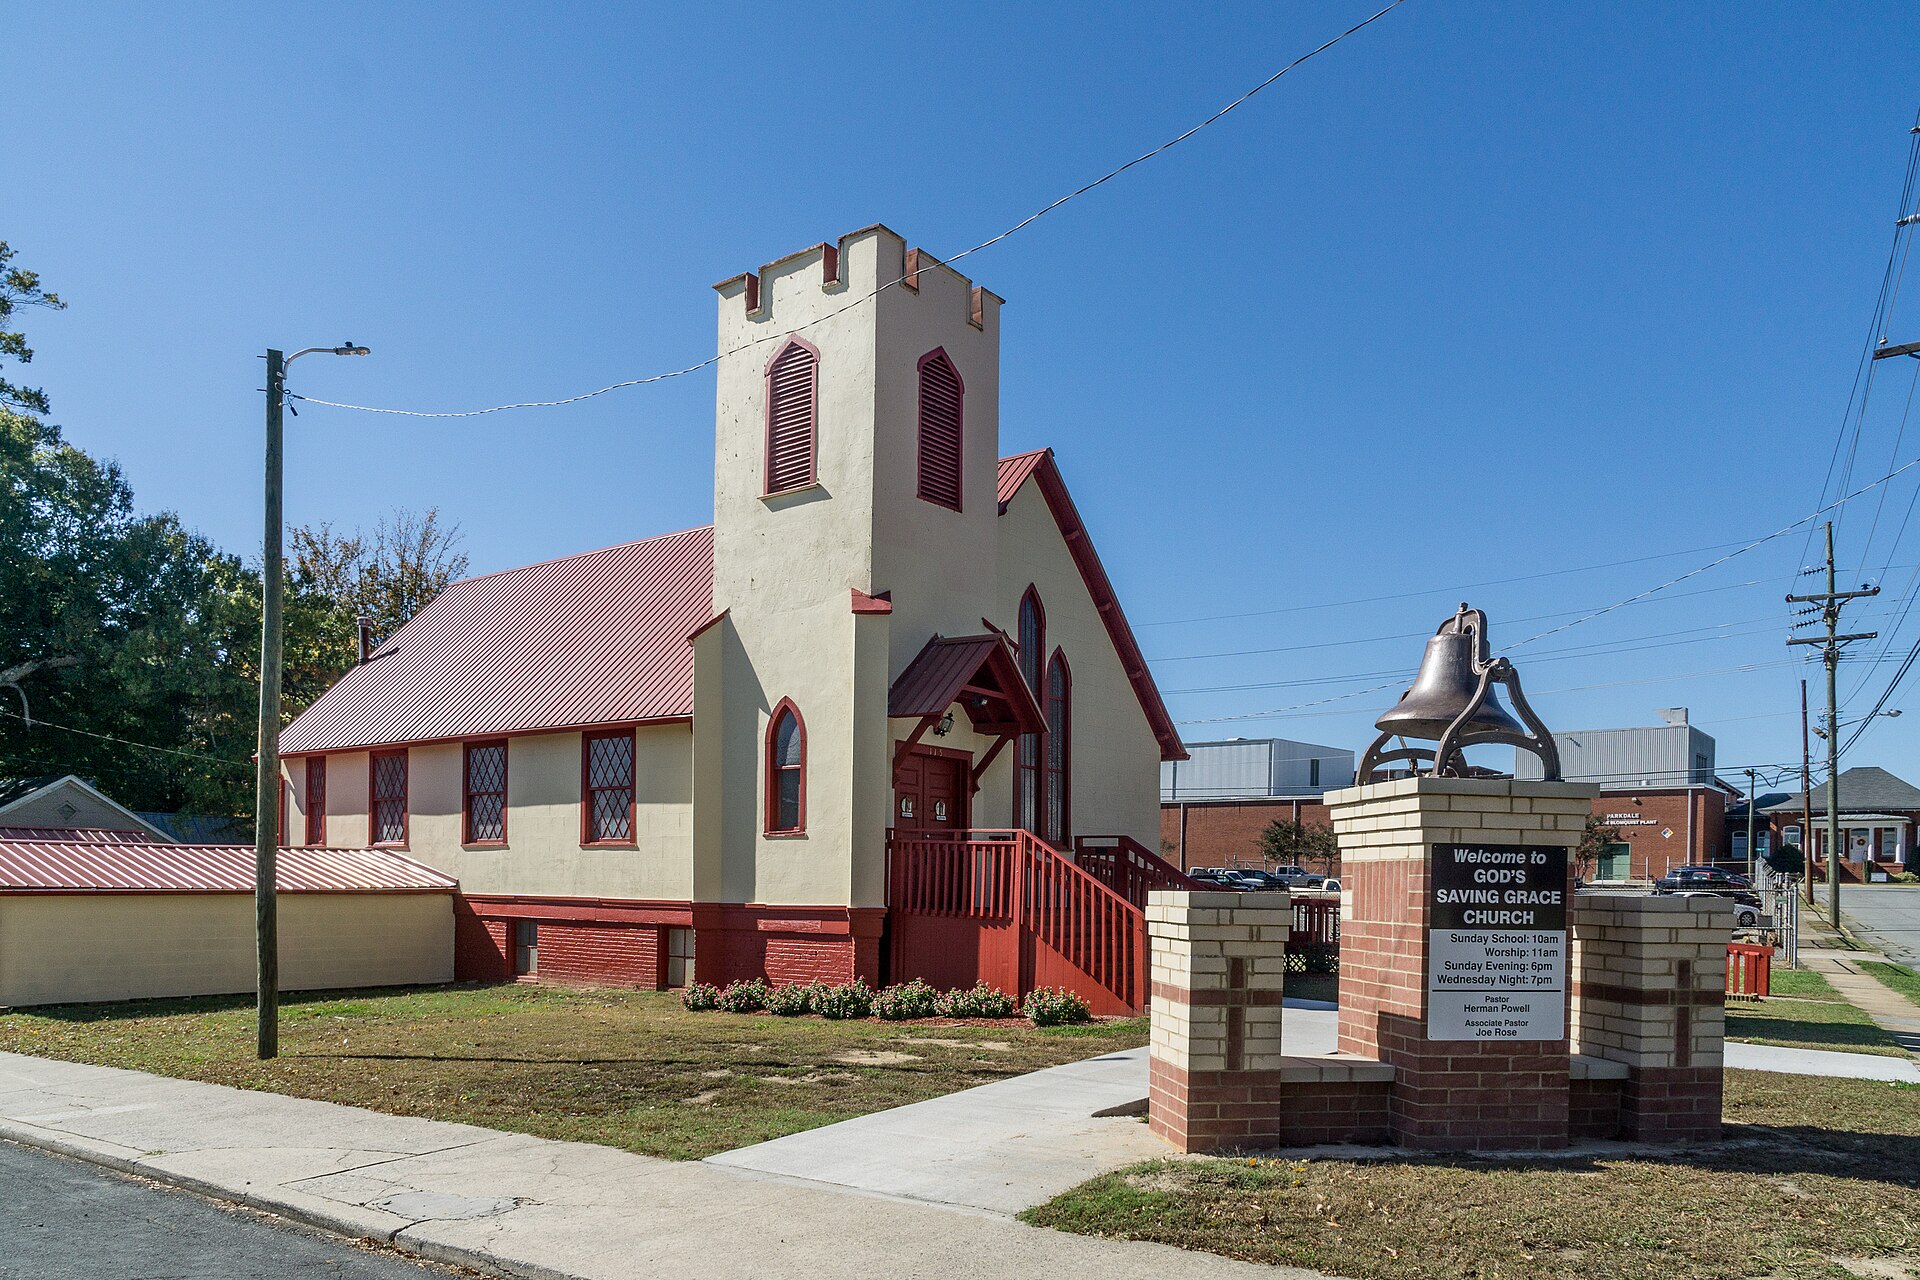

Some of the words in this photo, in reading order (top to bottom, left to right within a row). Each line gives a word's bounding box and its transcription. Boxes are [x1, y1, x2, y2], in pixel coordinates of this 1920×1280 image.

[1454, 849, 1526, 864] Welcome
[1530, 851, 1546, 864] to
[1474, 869, 1526, 883] GOD'S
[1436, 889, 1499, 904] SAVING
[1504, 890, 1561, 904] GRACE
[1463, 910, 1534, 924] CHURCH
[1450, 933, 1489, 945] Sunday
[1491, 934, 1530, 943] School:
[1532, 934, 1559, 944] 10am
[1484, 947, 1529, 959] Worship:
[1532, 948, 1558, 957] 11am
[1444, 960, 1483, 973] Sunday
[1485, 961, 1529, 973] Evening:
[1531, 961, 1553, 973] 6pm
[1437, 974, 1496, 986] Wednesday
[1499, 975, 1529, 986] Night:
[1531, 975, 1552, 986] 7pm
[1485, 995, 1510, 1003] Pastor
[1463, 1004, 1499, 1013] Herman
[1501, 1004, 1530, 1013] Powell
[1464, 1019, 1503, 1027] Associate
[1504, 1019, 1529, 1027] Pastor
[1475, 1028, 1492, 1036] Joe
[1495, 1028, 1517, 1036] Rose
